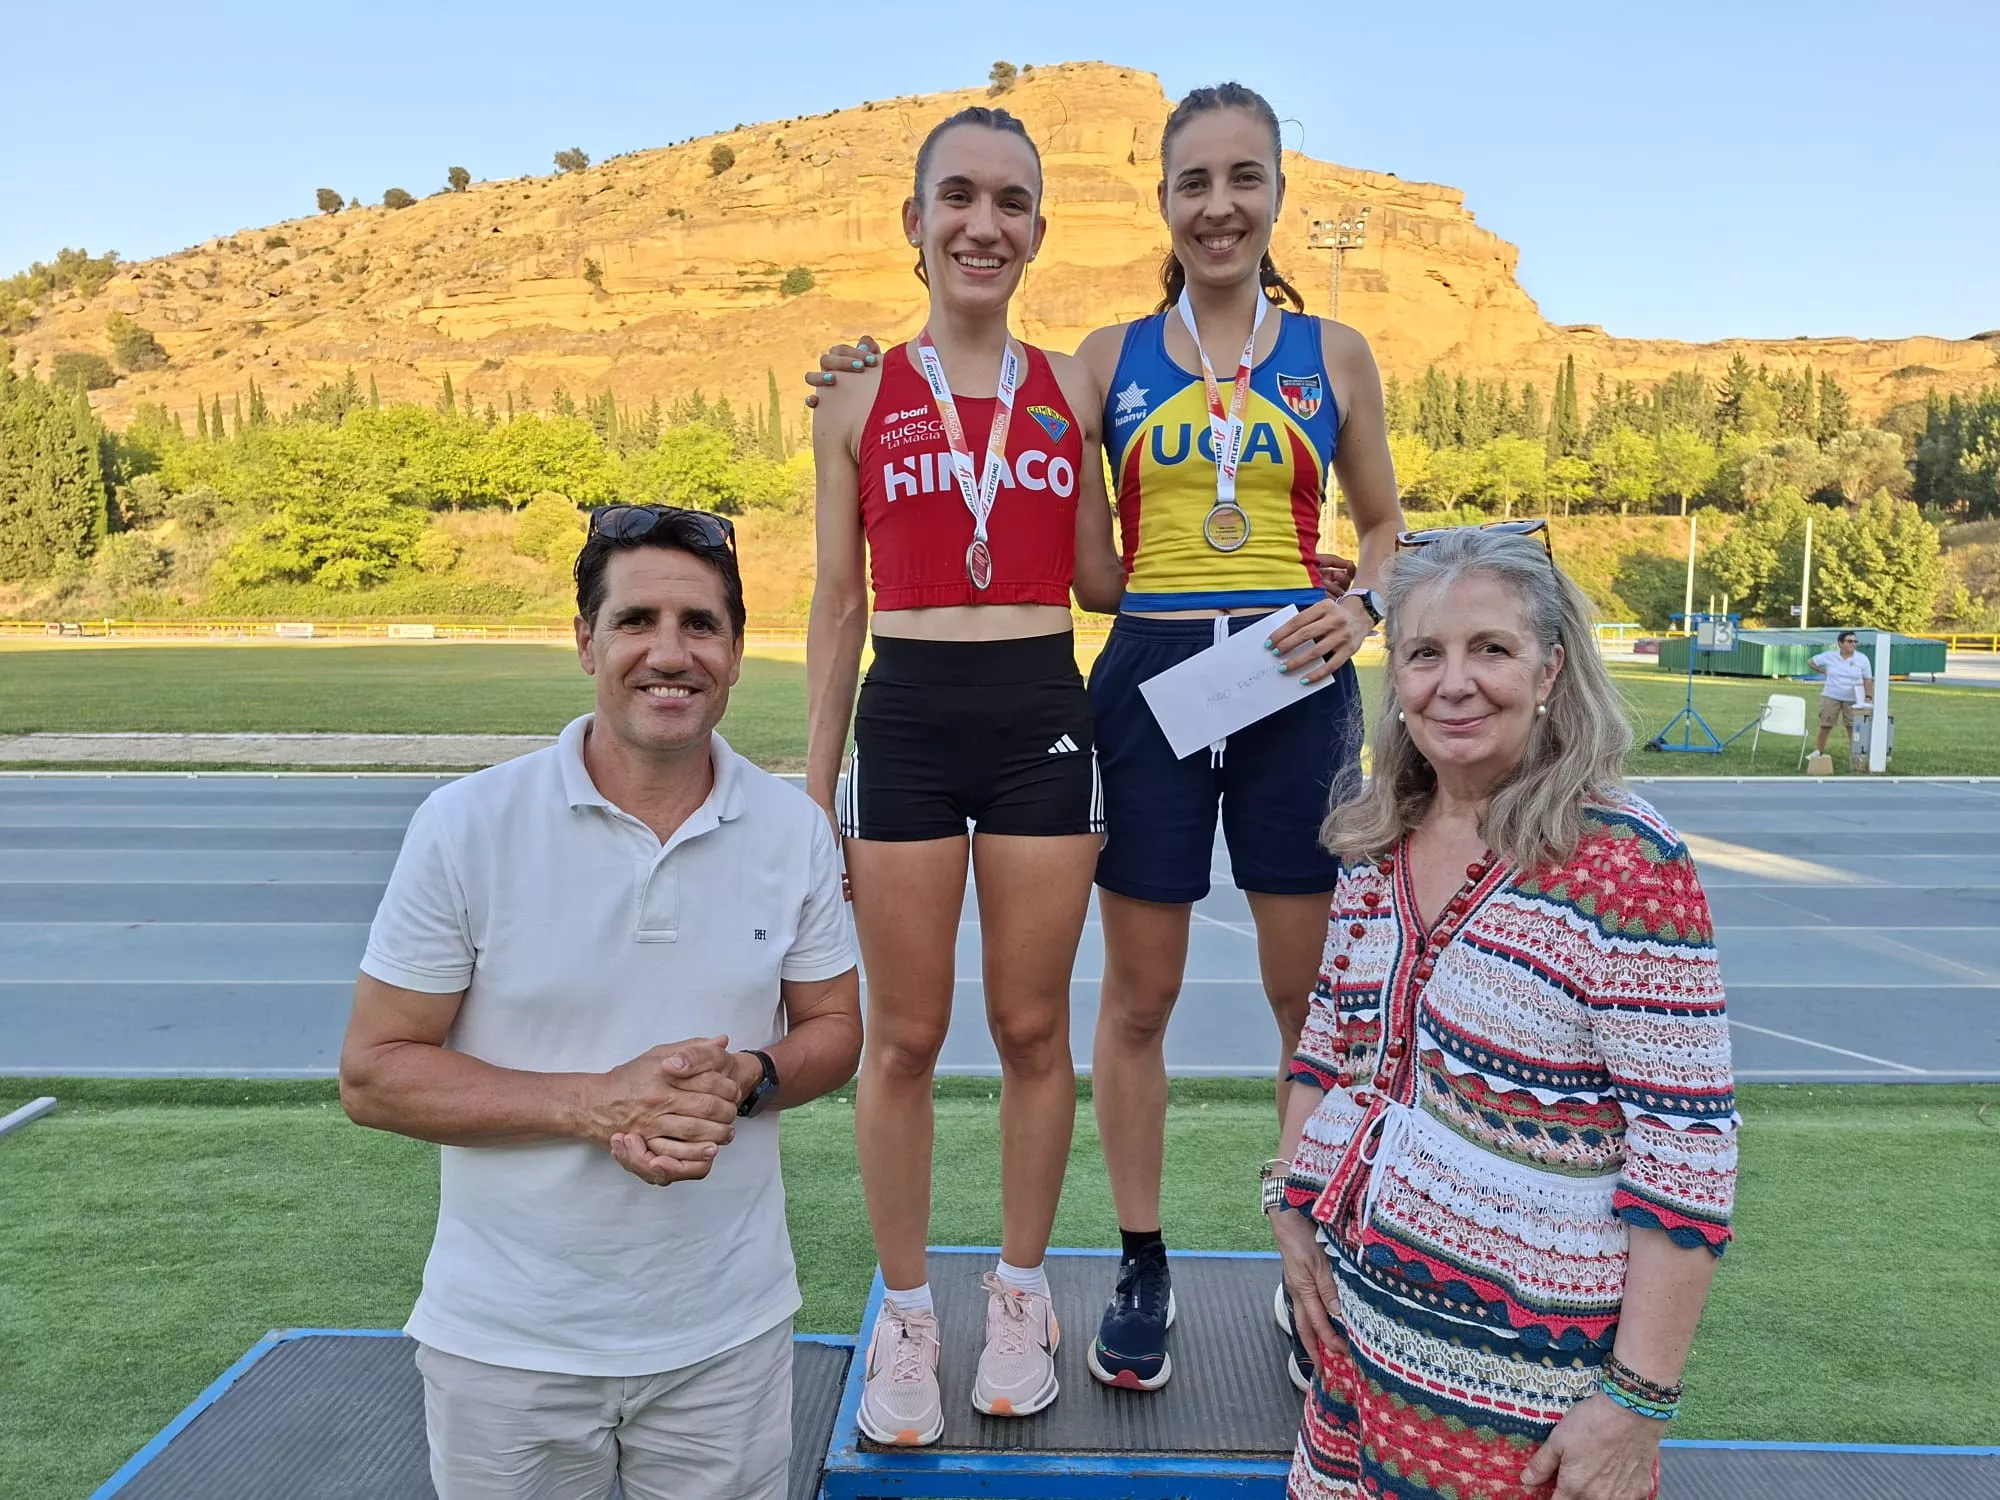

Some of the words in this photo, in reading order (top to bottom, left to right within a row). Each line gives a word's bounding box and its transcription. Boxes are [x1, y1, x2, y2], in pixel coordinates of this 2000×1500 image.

[1115, 408, 1147, 428] luanvi
[1230, 425, 1242, 464] ATLETISMO
[987, 463, 1000, 505] ATLETISMO
